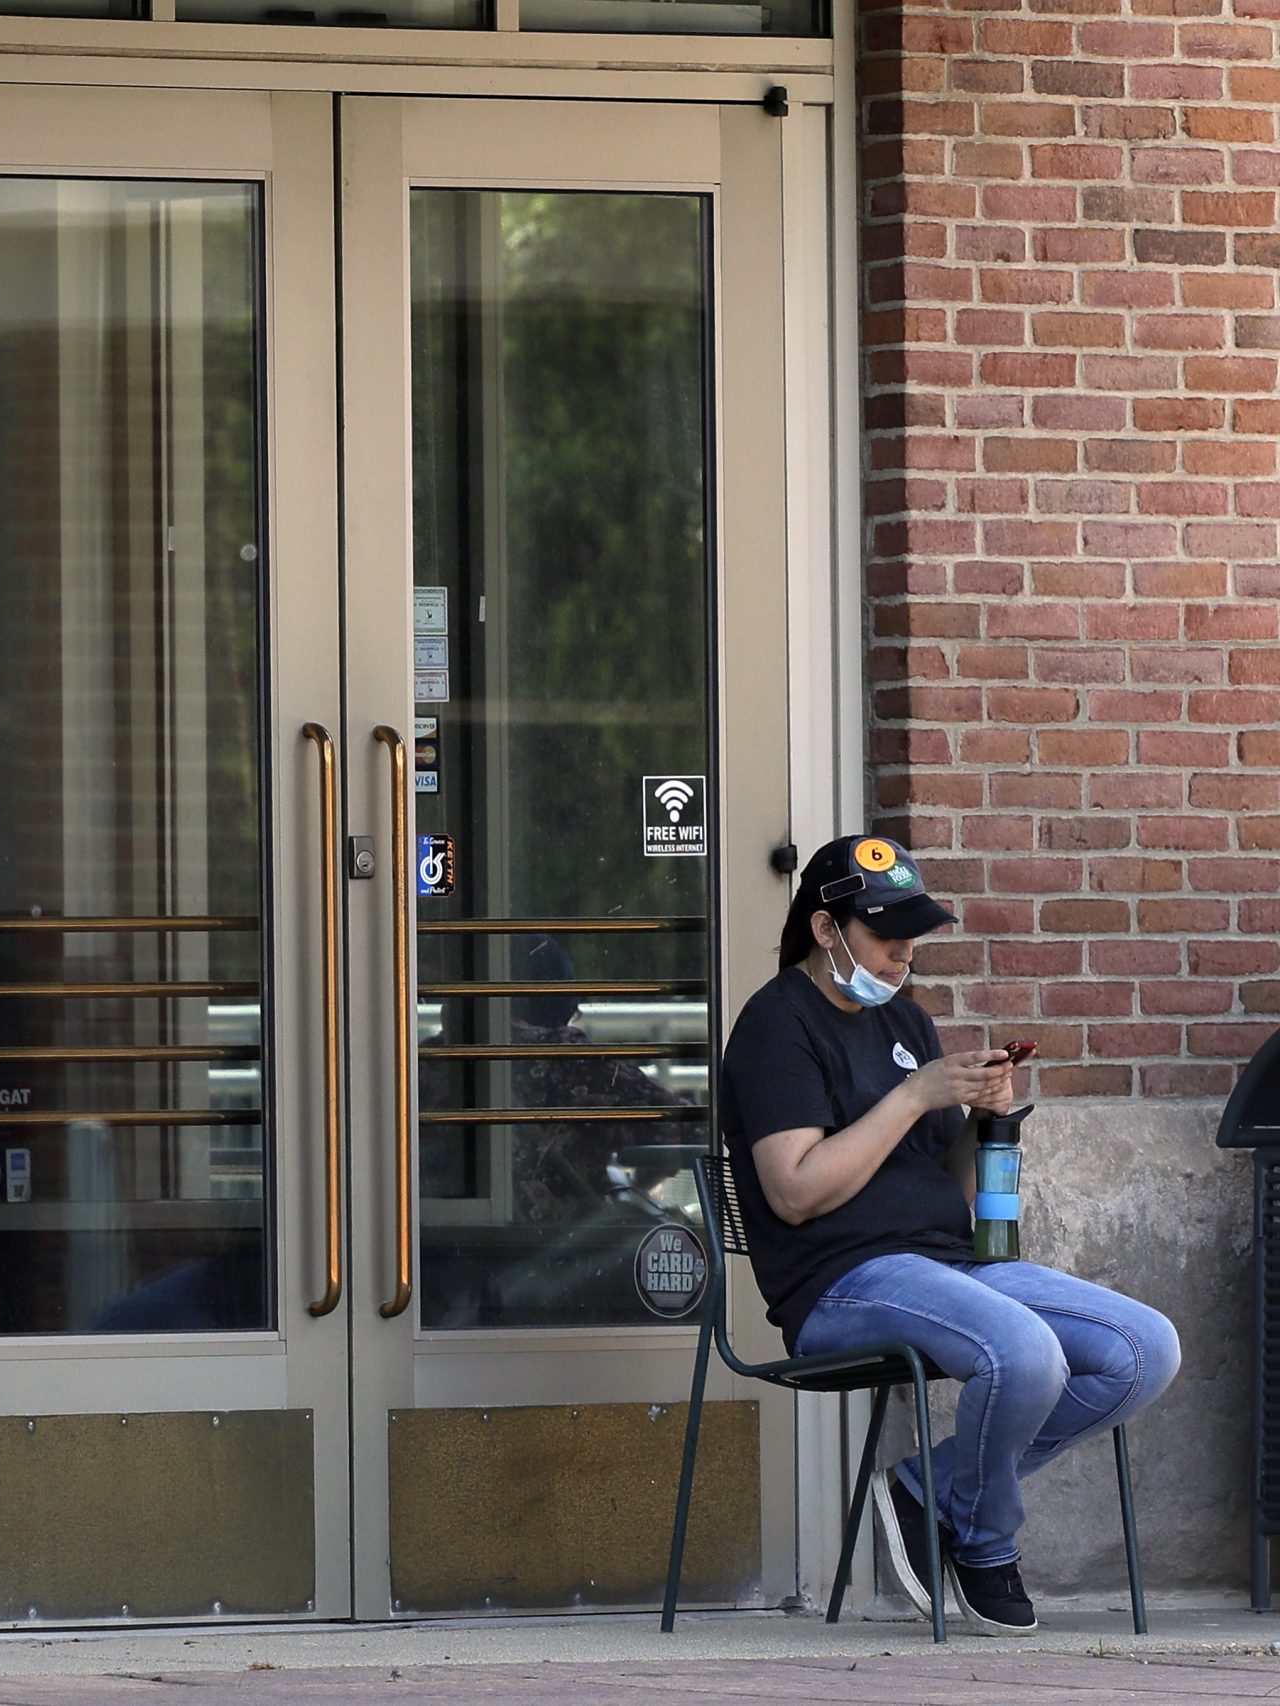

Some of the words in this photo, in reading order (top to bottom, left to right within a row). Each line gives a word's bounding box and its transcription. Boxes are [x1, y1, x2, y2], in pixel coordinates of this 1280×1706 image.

[415, 775, 436, 787] VISA
[647, 826, 676, 840] FREE
[678, 826, 703, 840] WIFI
[647, 844, 675, 852] WIRELESS
[676, 844, 703, 852] INTERNET
[660, 1234, 682, 1252] We
[647, 1252, 693, 1273] CARD
[647, 1272, 693, 1292] HARD
